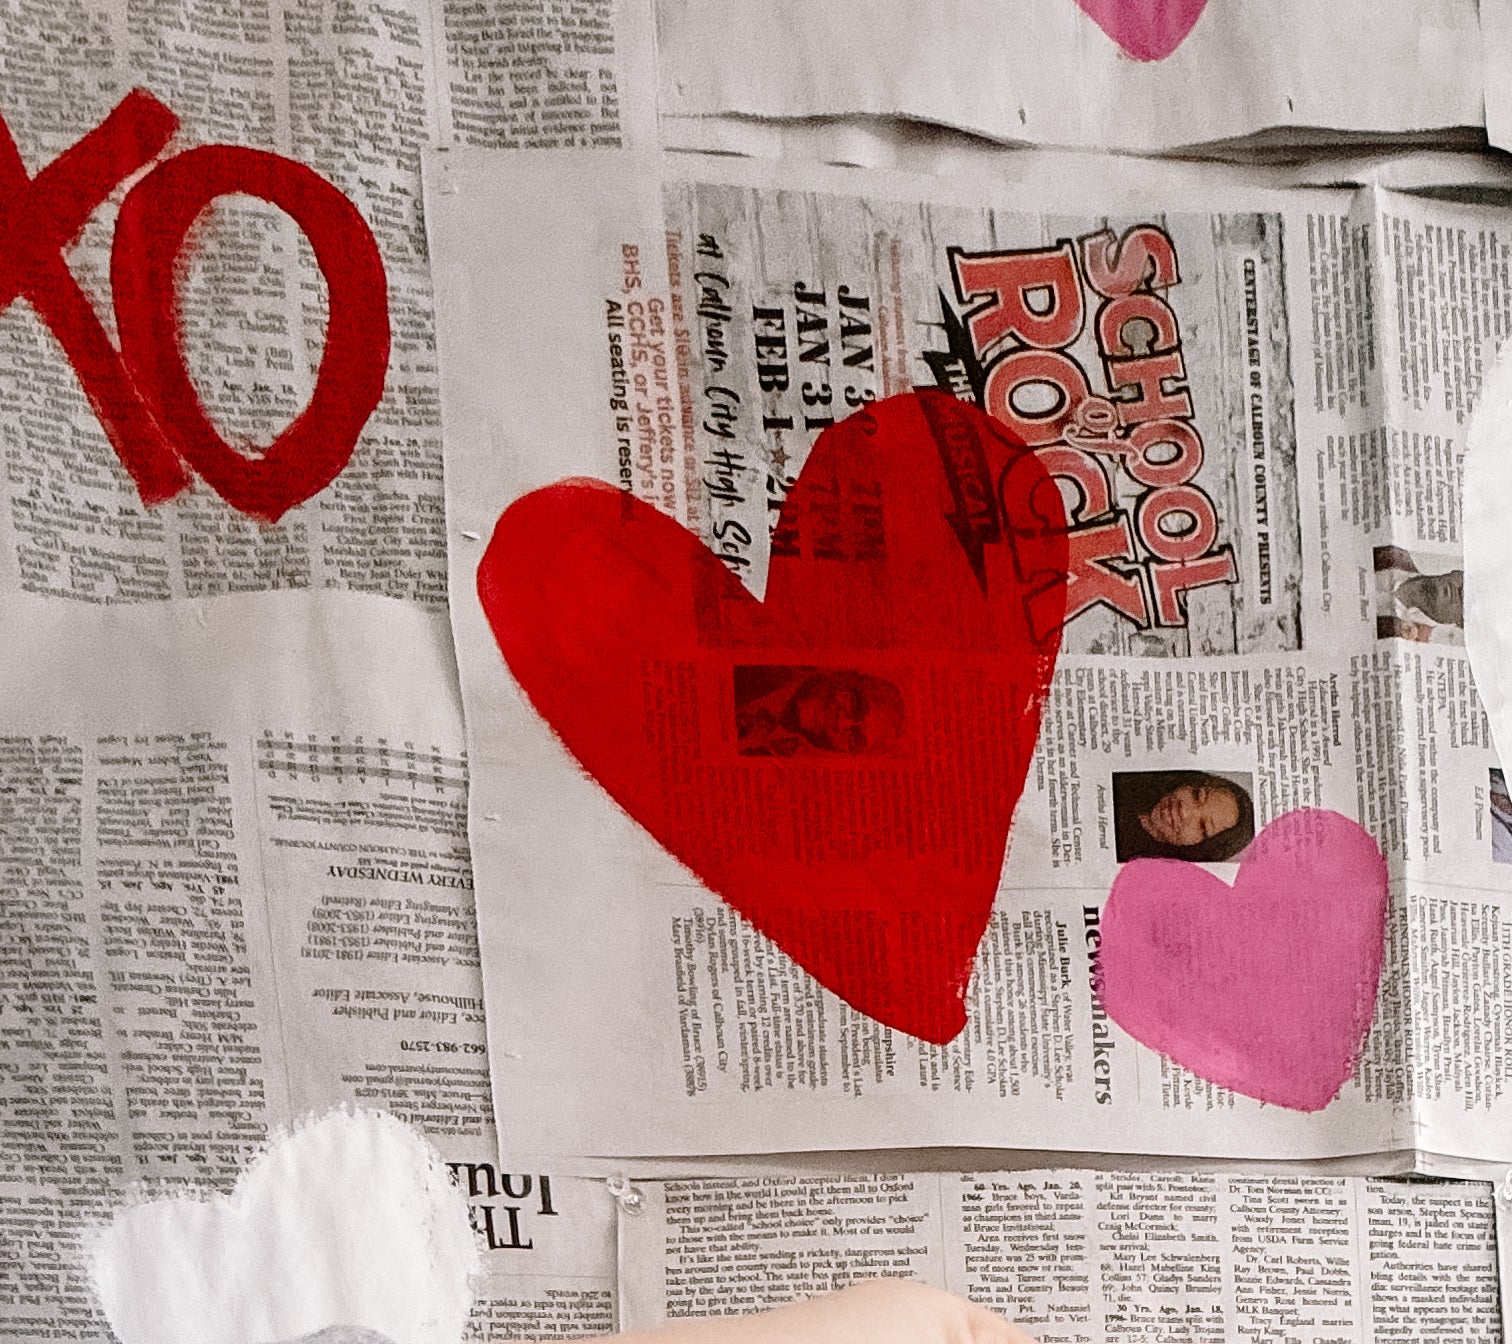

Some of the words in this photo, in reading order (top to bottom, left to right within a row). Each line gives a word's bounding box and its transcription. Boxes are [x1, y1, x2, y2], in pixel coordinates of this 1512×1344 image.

[696, 228, 726, 260] at
[693, 267, 734, 378] Calhoun
[793, 279, 830, 380] JAN
[1243, 258, 1260, 366] CENTERSTAGE
[752, 300, 789, 398] FEB
[942, 360, 977, 404] THE
[1249, 370, 1261, 389] OF
[702, 381, 740, 441] City
[762, 399, 794, 441] 1
[800, 380, 839, 441] 31
[947, 238, 1151, 650] ROCK
[1078, 225, 1238, 628] SCHOOL
[1250, 392, 1265, 459] CALHOUN
[701, 447, 745, 517] High
[1253, 463, 1268, 526] COUNTY
[1257, 531, 1271, 605] PRESENTS
